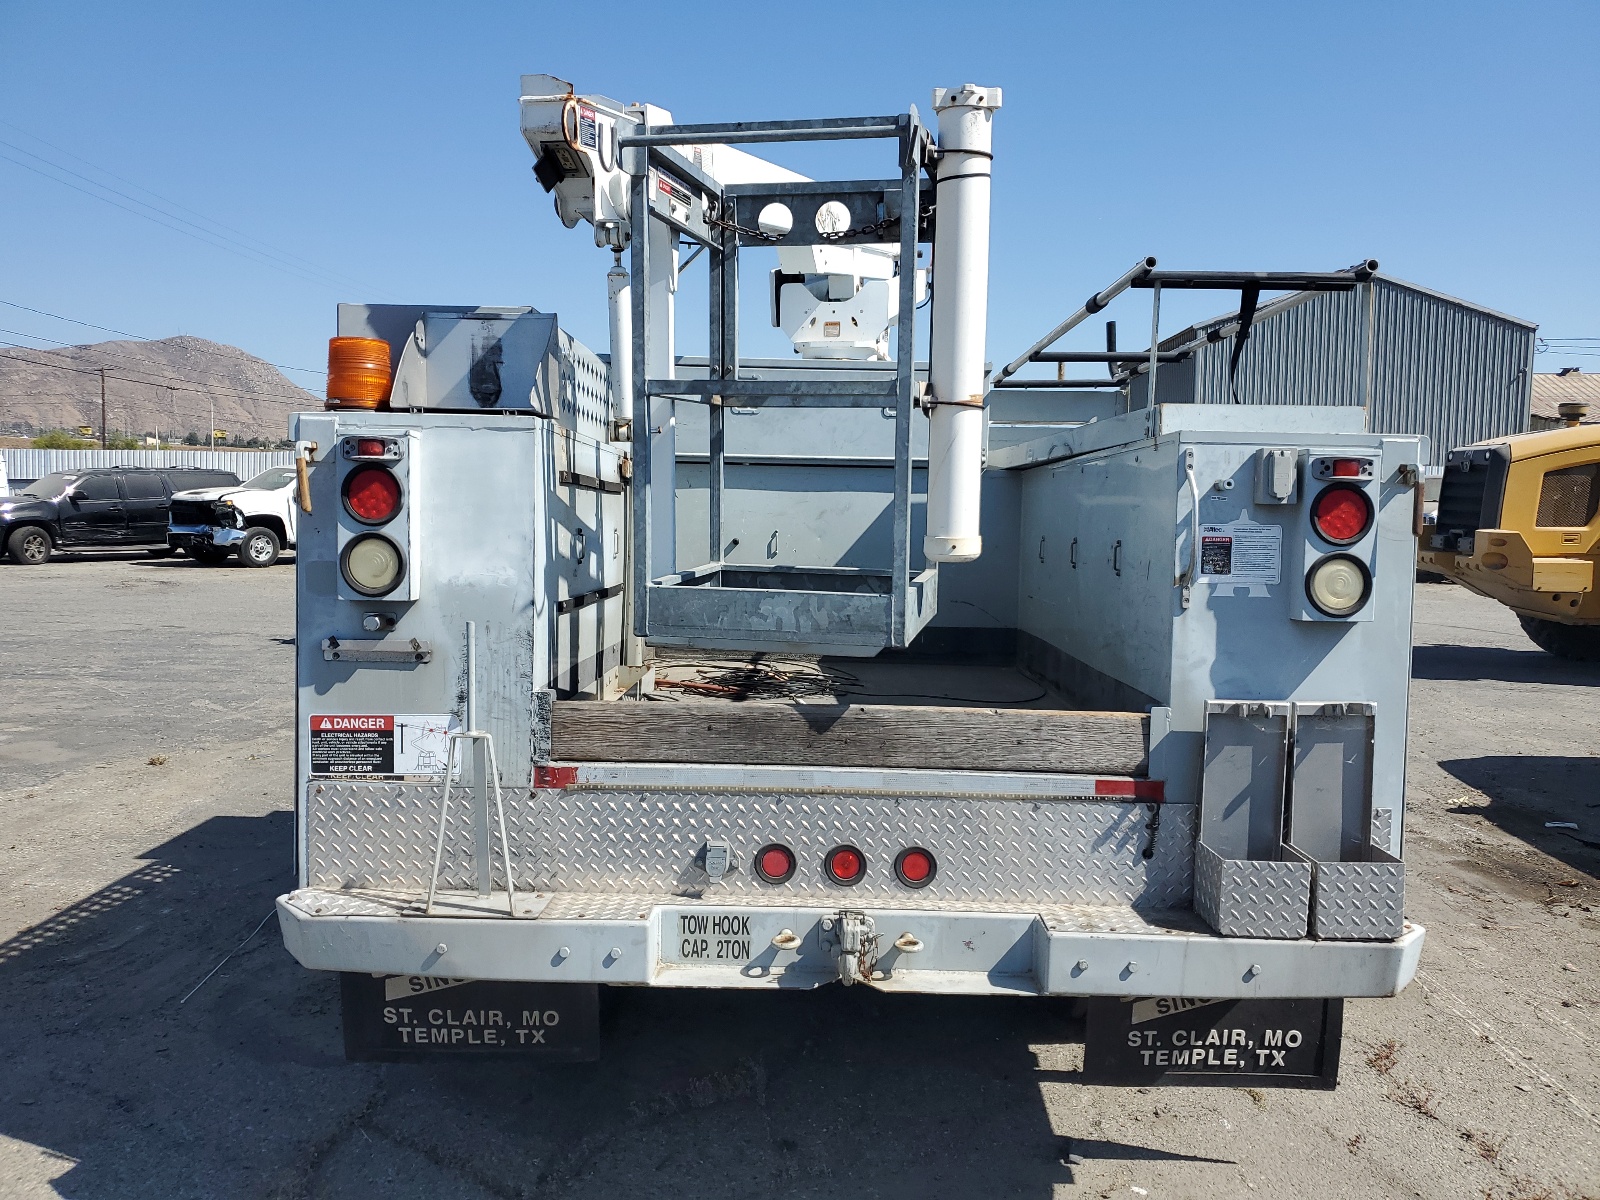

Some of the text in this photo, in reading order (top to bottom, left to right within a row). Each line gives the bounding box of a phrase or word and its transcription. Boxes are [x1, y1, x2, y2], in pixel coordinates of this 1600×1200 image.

[334, 718, 385, 729] DANGER
[681, 915, 750, 936] TOW HOOK
[682, 939, 750, 959] CAP. 2TON
[383, 1007, 560, 1028] ST. CLAIR, MO
[398, 1027, 546, 1046] TEMPLE, TX
[1127, 1029, 1303, 1049] ST. CLAIR, MO
[1140, 1049, 1286, 1068] TEMPLE, TX
